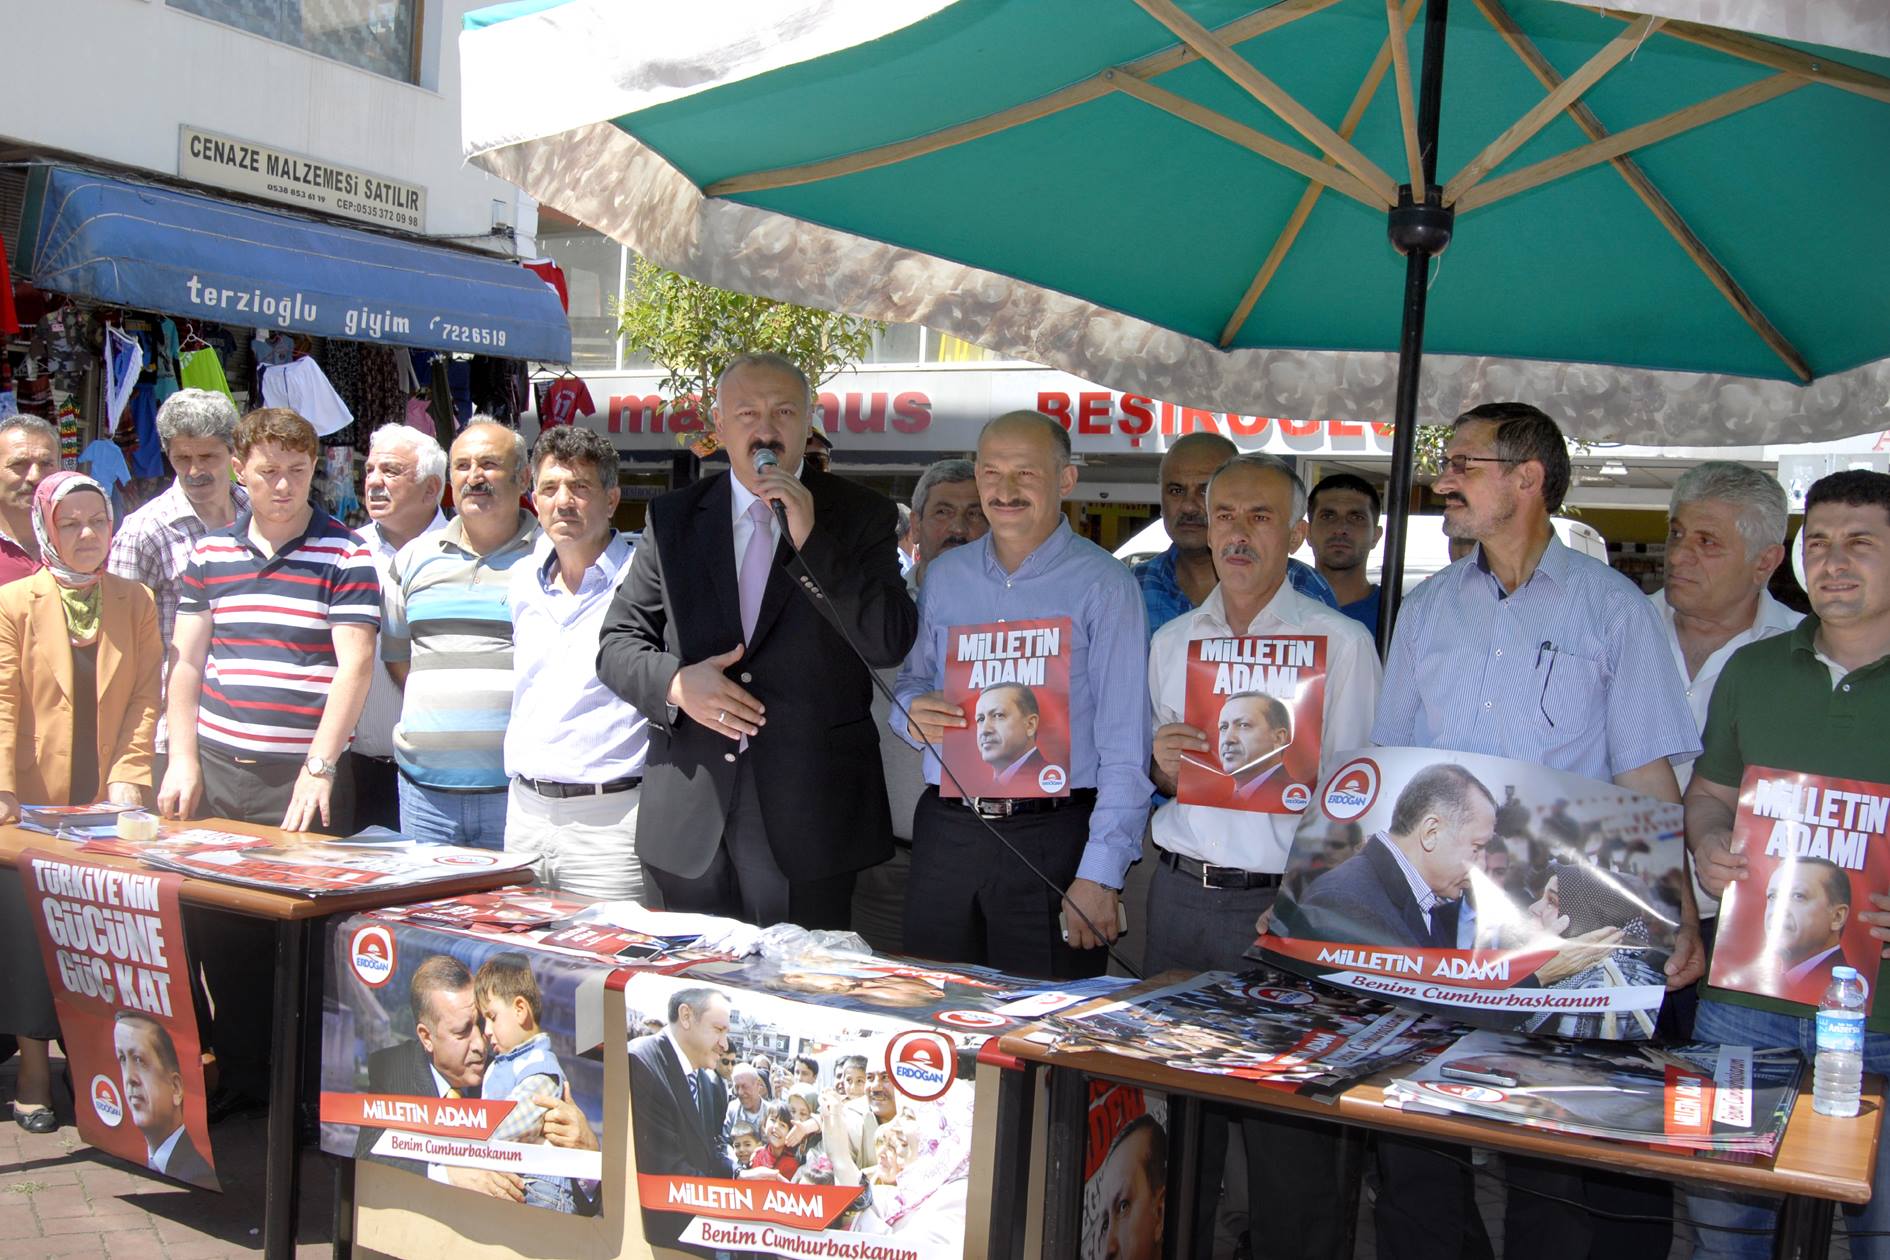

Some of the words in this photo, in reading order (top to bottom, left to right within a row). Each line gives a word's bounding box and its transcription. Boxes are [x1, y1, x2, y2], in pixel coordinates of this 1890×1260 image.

[190, 135, 260, 172] CENAZE
[364, 178, 419, 211] SATILIR
[379, 208, 394, 221] 372
[396, 213, 406, 223] 09
[408, 216, 419, 227] 98
[345, 306, 410, 338] giyim
[442, 323, 507, 347] 7226519
[968, 657, 1046, 689] ADAMI
[1213, 663, 1298, 699] ADAMI
[1765, 820, 1869, 871] ADAMI
[42, 897, 168, 968] GÜCÜNE
[1432, 957, 1511, 982] ADAMI
[114, 962, 174, 1018] KAT
[1351, 975, 1417, 996] Benim
[434, 1106, 488, 1129] ADAMI
[391, 1136, 424, 1151] Benim
[763, 1188, 824, 1218] ADAMI
[701, 1222, 757, 1246] Benim
